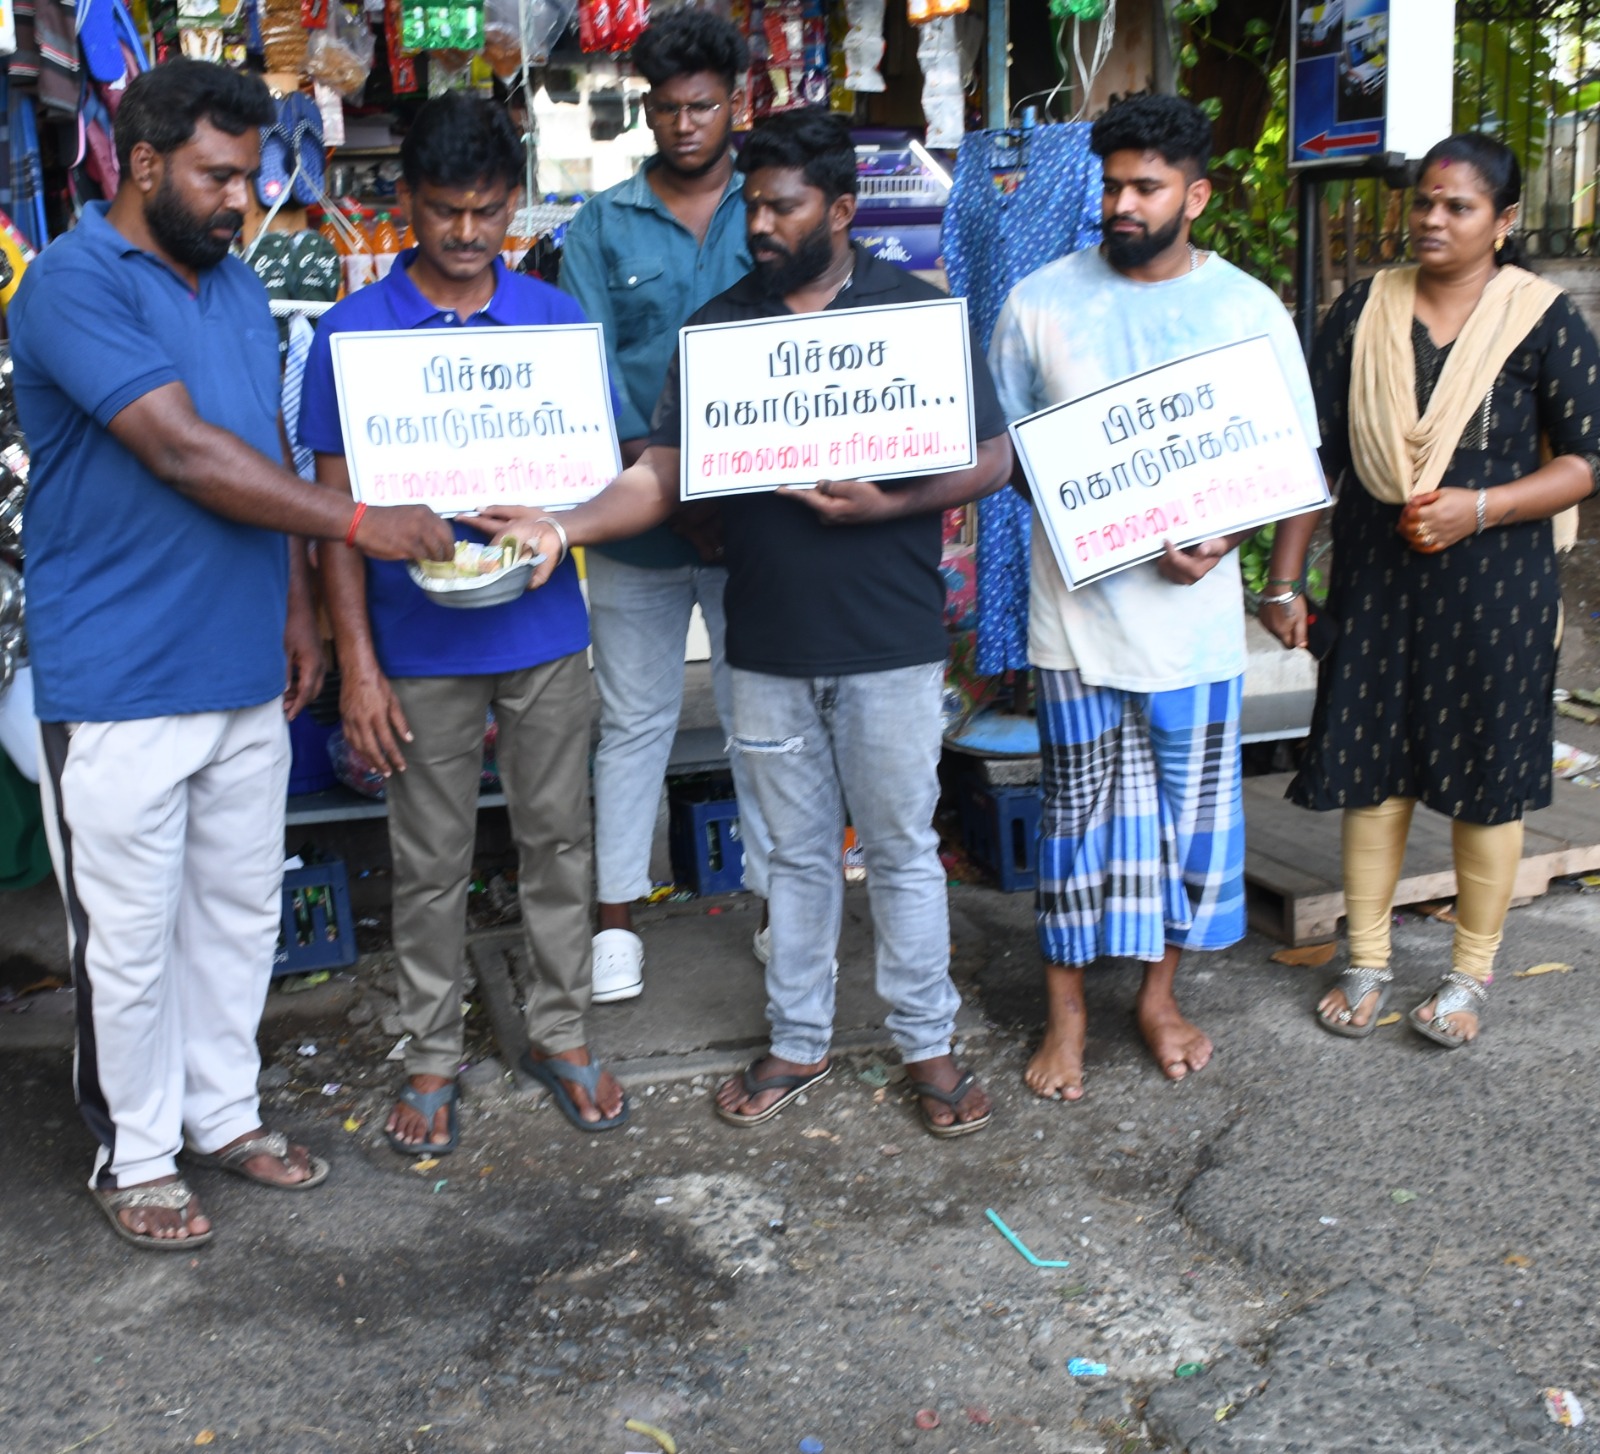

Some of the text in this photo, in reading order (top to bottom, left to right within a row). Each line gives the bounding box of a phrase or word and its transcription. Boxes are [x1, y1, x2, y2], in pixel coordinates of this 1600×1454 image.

[423, 355, 535, 393] பிச்சை
[768, 340, 887, 378] பிச்சை
[366, 401, 600, 448] கொடுங்கள்...
[705, 377, 955, 428] கொடுங்கள்...
[1102, 382, 1215, 445] பிச்சை
[702, 426, 966, 477] சாலையை சரிசெய்ய...
[1058, 415, 1294, 510] கொடுங்கள்...
[374, 467, 487, 500] சாலையை
